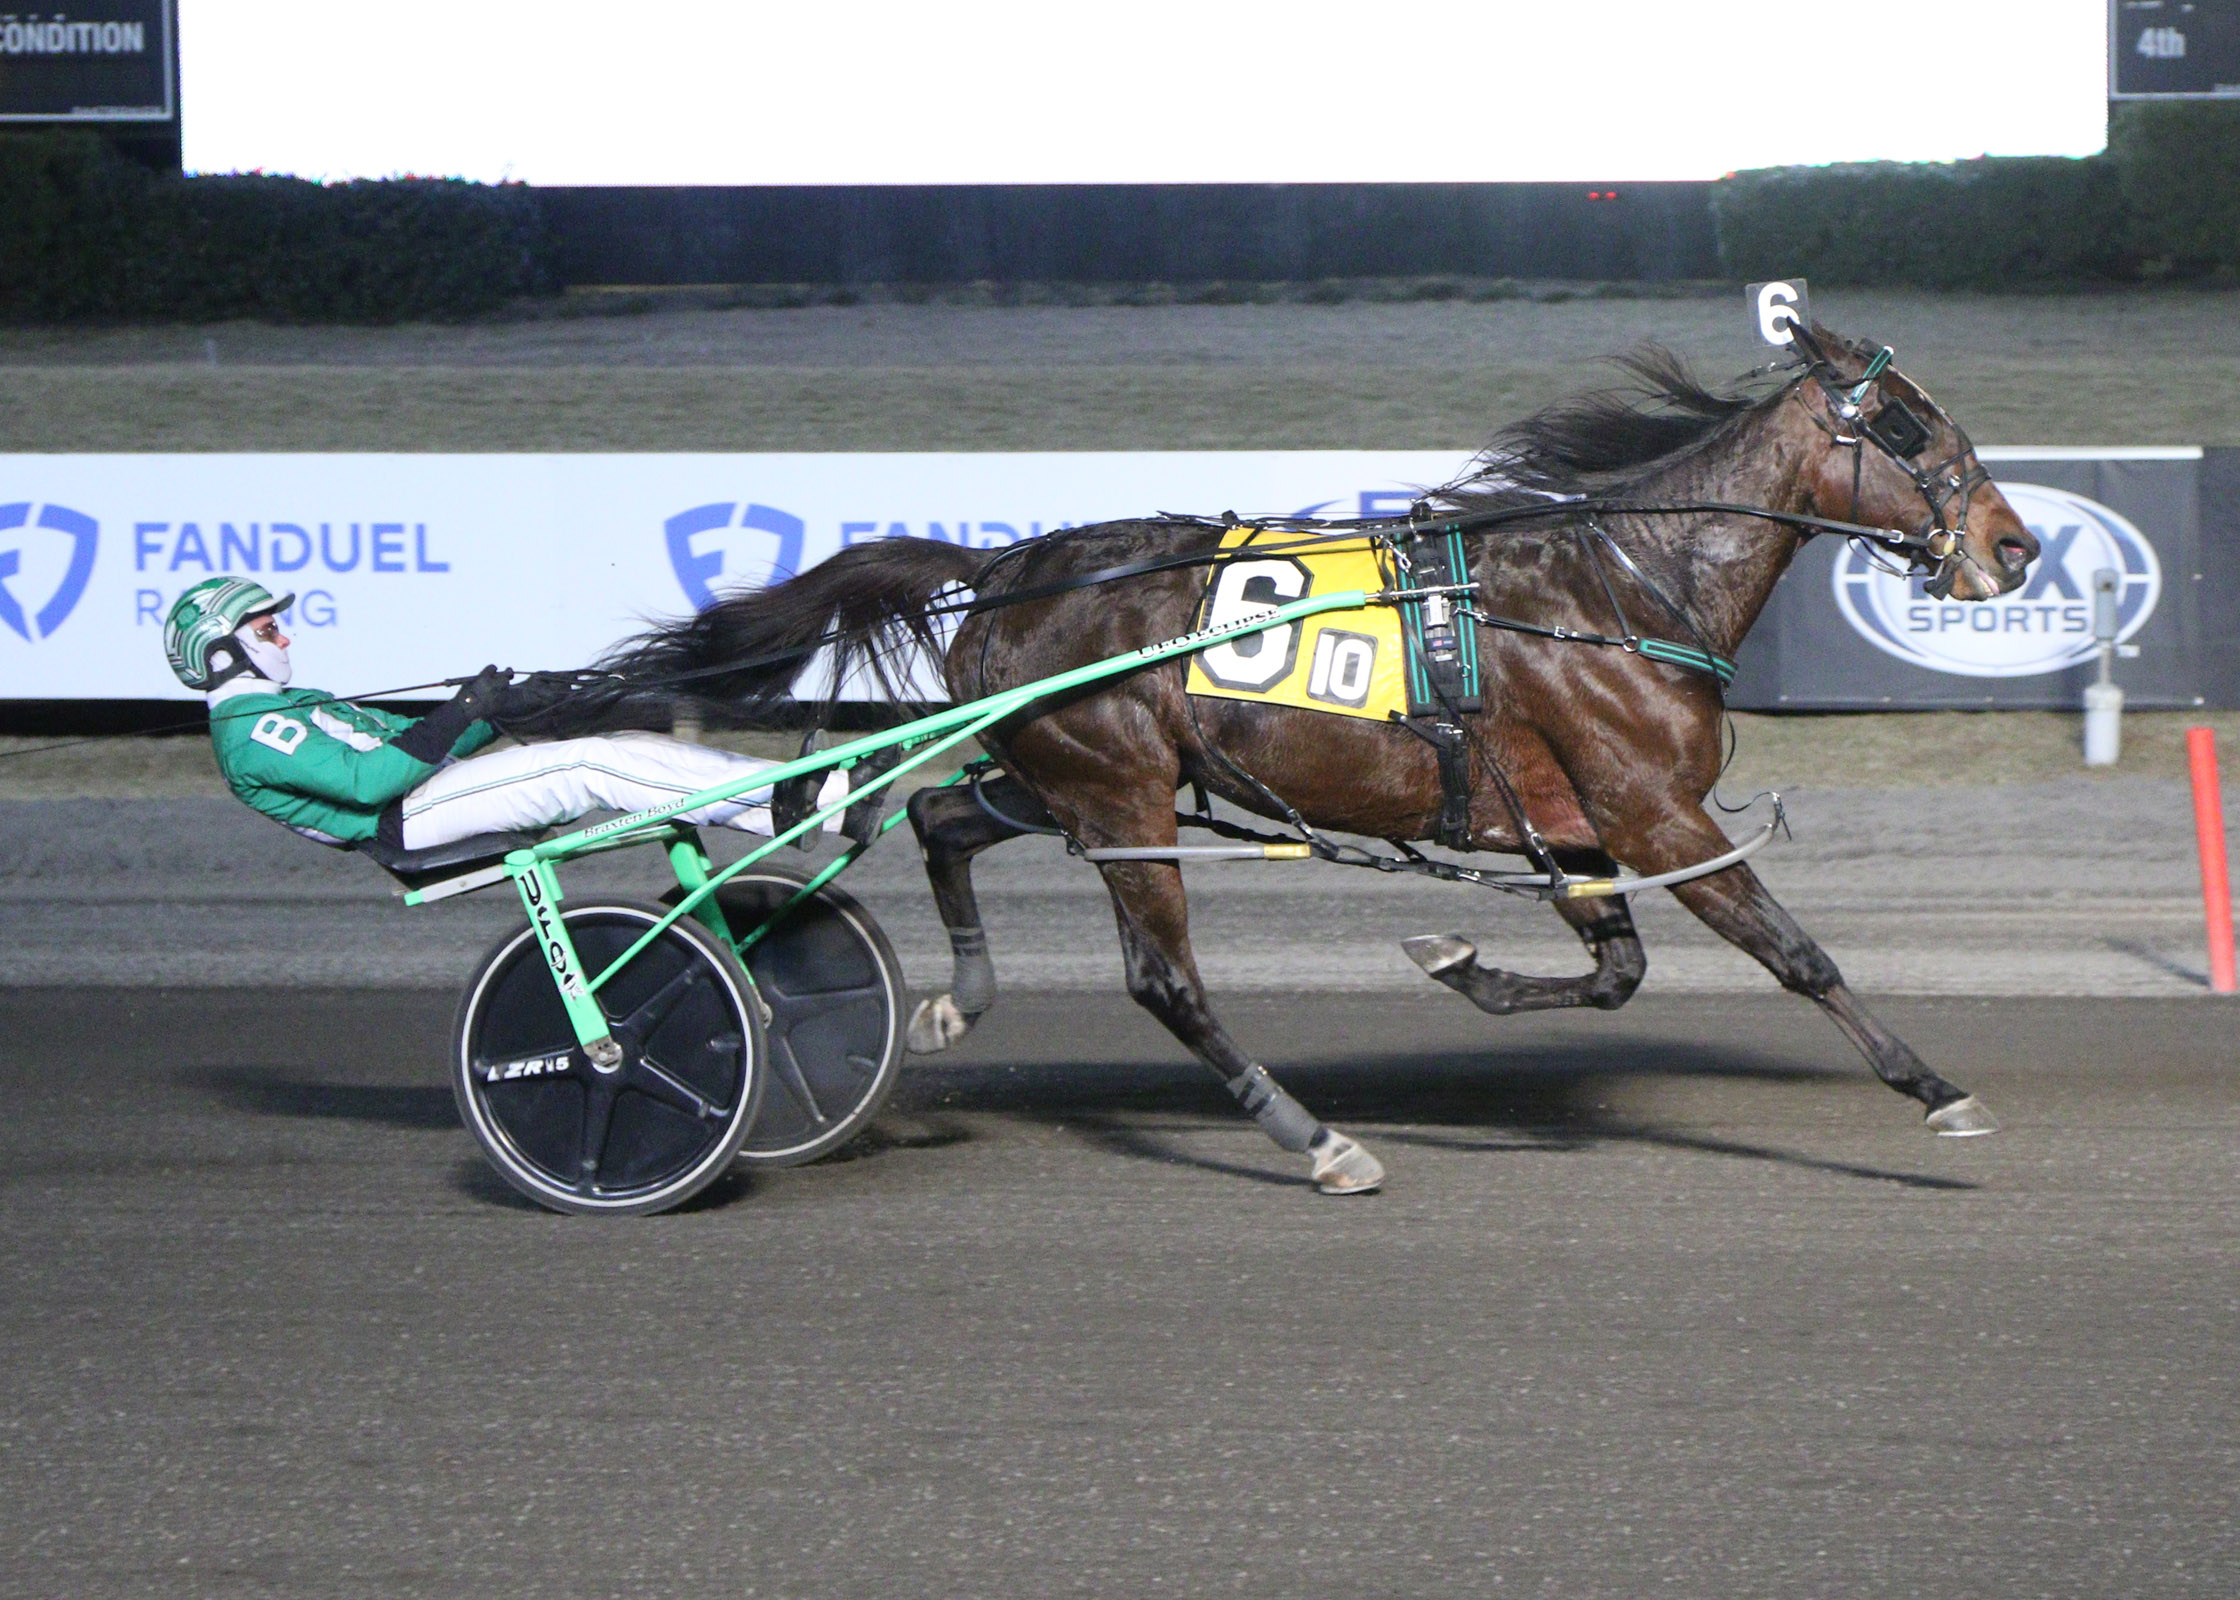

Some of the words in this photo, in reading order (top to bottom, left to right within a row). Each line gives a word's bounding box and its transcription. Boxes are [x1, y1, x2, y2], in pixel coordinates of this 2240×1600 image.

[1757, 281, 1801, 346] 6
[134, 521, 451, 573] FANDUEL
[1200, 557, 1307, 687] 6
[1908, 606, 2087, 633] SPORTS
[1309, 632, 1375, 701] 10
[250, 712, 308, 756] B
[584, 813, 644, 839] Braxten
[647, 798, 685, 818] Boyd
